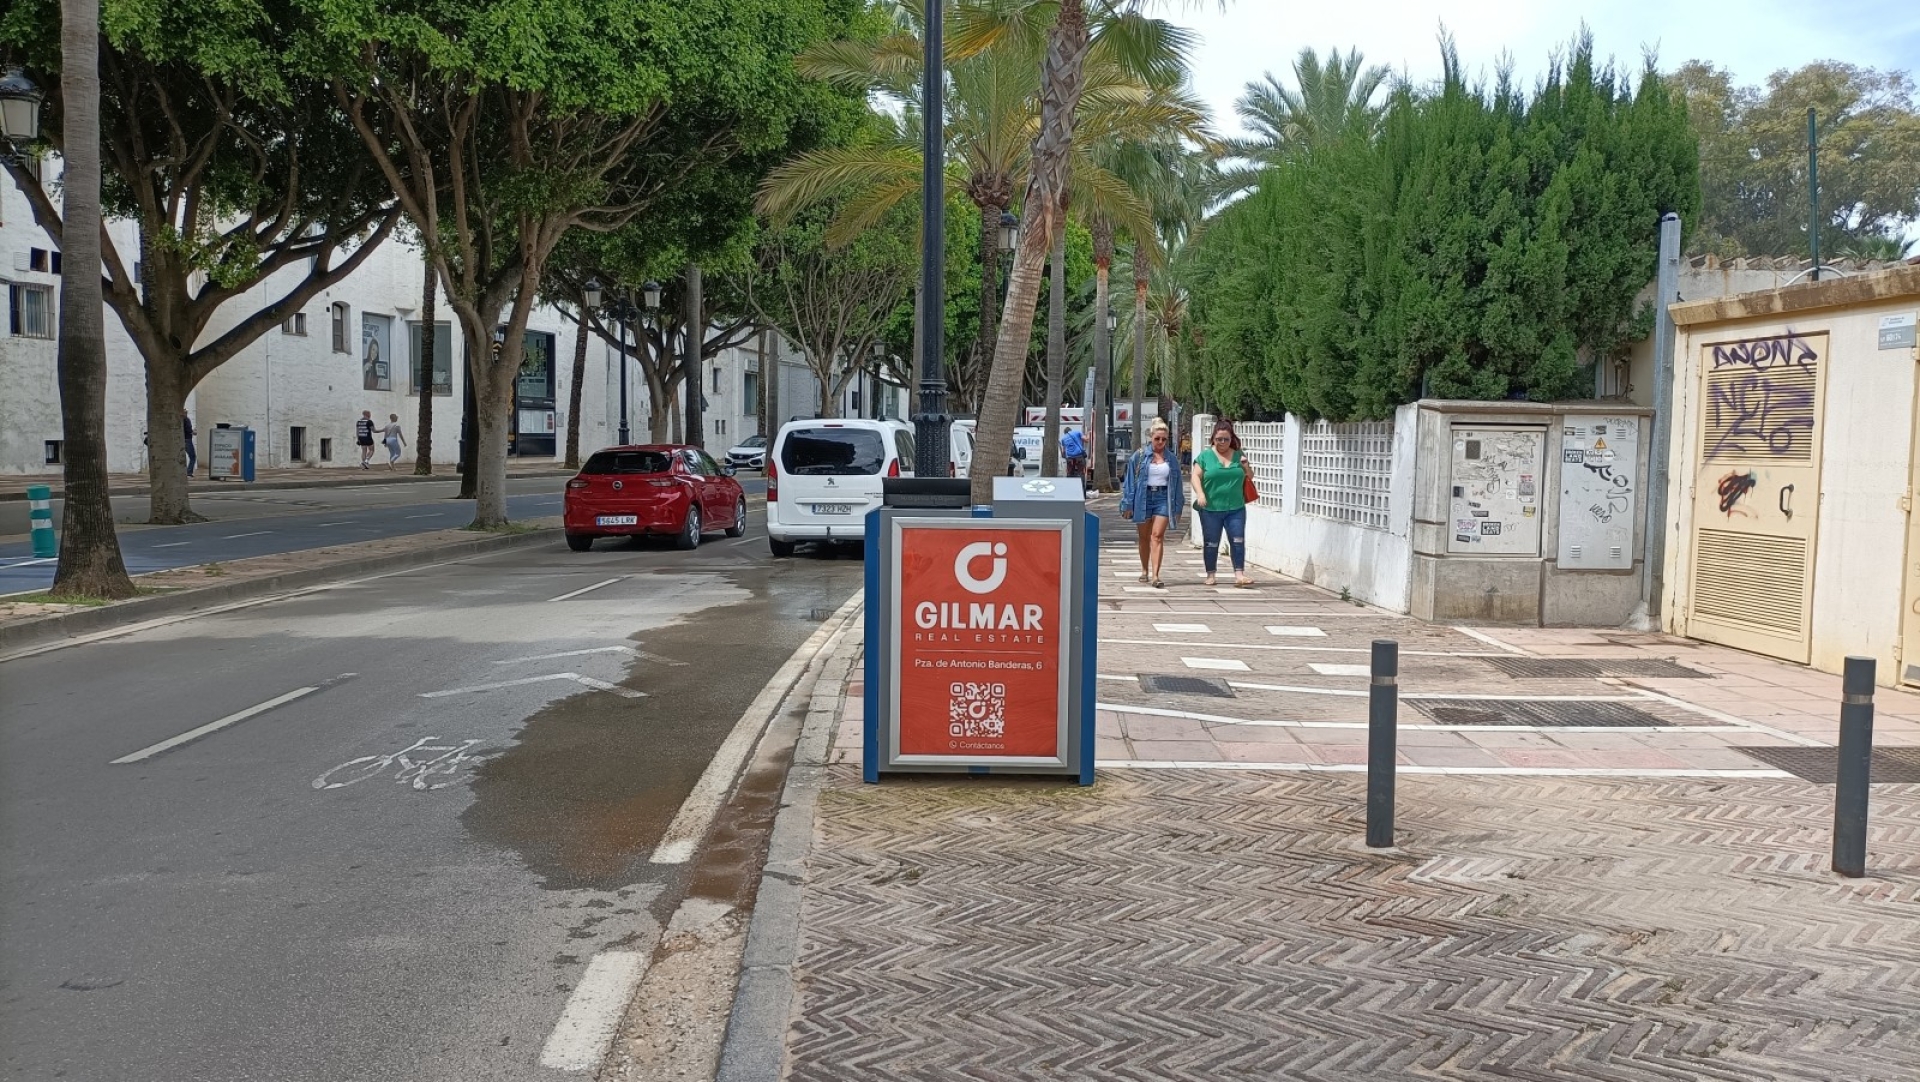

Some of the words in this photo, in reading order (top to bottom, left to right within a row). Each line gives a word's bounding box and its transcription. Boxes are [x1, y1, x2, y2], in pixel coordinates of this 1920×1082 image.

[817, 504, 835, 513] 7323
[915, 601, 1043, 631] GILMAR
[915, 633, 960, 641] REAL
[975, 634, 1043, 643] ESTATE
[915, 659, 934, 668] Pza.
[936, 660, 948, 668] de
[950, 660, 986, 669] Antonio
[988, 660, 1034, 671] Banderas,
[1036, 662, 1043, 670] 6
[959, 741, 1005, 749] Contáctanos
